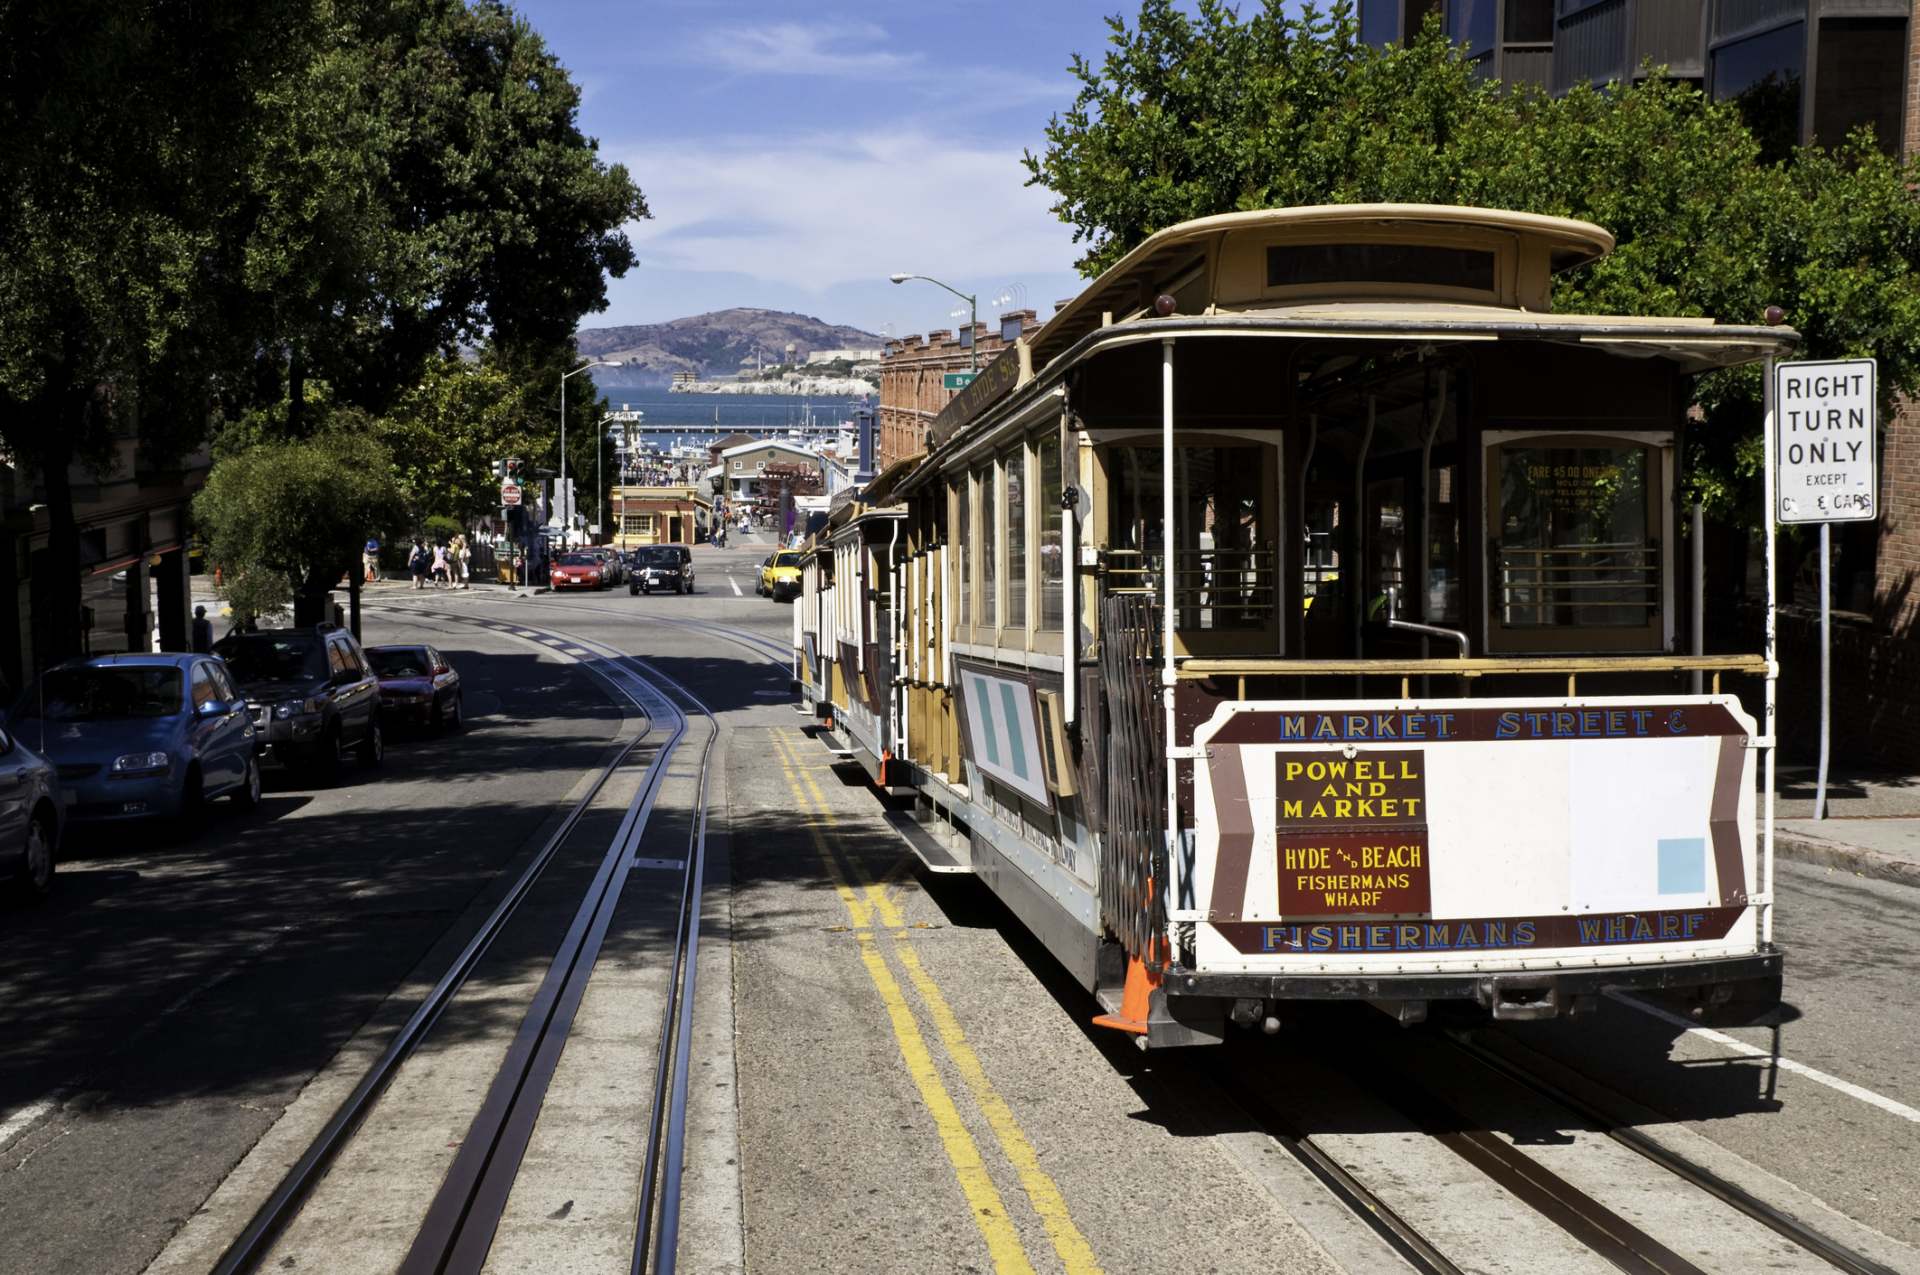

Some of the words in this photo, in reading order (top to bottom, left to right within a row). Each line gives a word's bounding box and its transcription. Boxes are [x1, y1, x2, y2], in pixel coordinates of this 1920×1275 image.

[1786, 375, 1864, 399] RIGHT
[1788, 408, 1864, 432] TURN
[1788, 441, 1863, 465] ONLY
[1527, 465, 1551, 479] FARE
[1806, 473, 1848, 486] EXCEPT
[1280, 713, 1455, 740] MARKET
[1496, 710, 1653, 738] STREET
[1668, 709, 1687, 733] &
[1285, 761, 1418, 781] POWELL
[1321, 782, 1387, 797] AND
[1284, 798, 1421, 818] MARKET
[1285, 847, 1331, 870] HYDE
[1336, 848, 1358, 869] AND
[1361, 845, 1422, 868] BEACH
[1297, 873, 1410, 891] FISHERMANS
[1324, 891, 1383, 907] WHARF
[1263, 921, 1537, 951] FISHERMANS
[1577, 912, 1705, 943] WHARF
